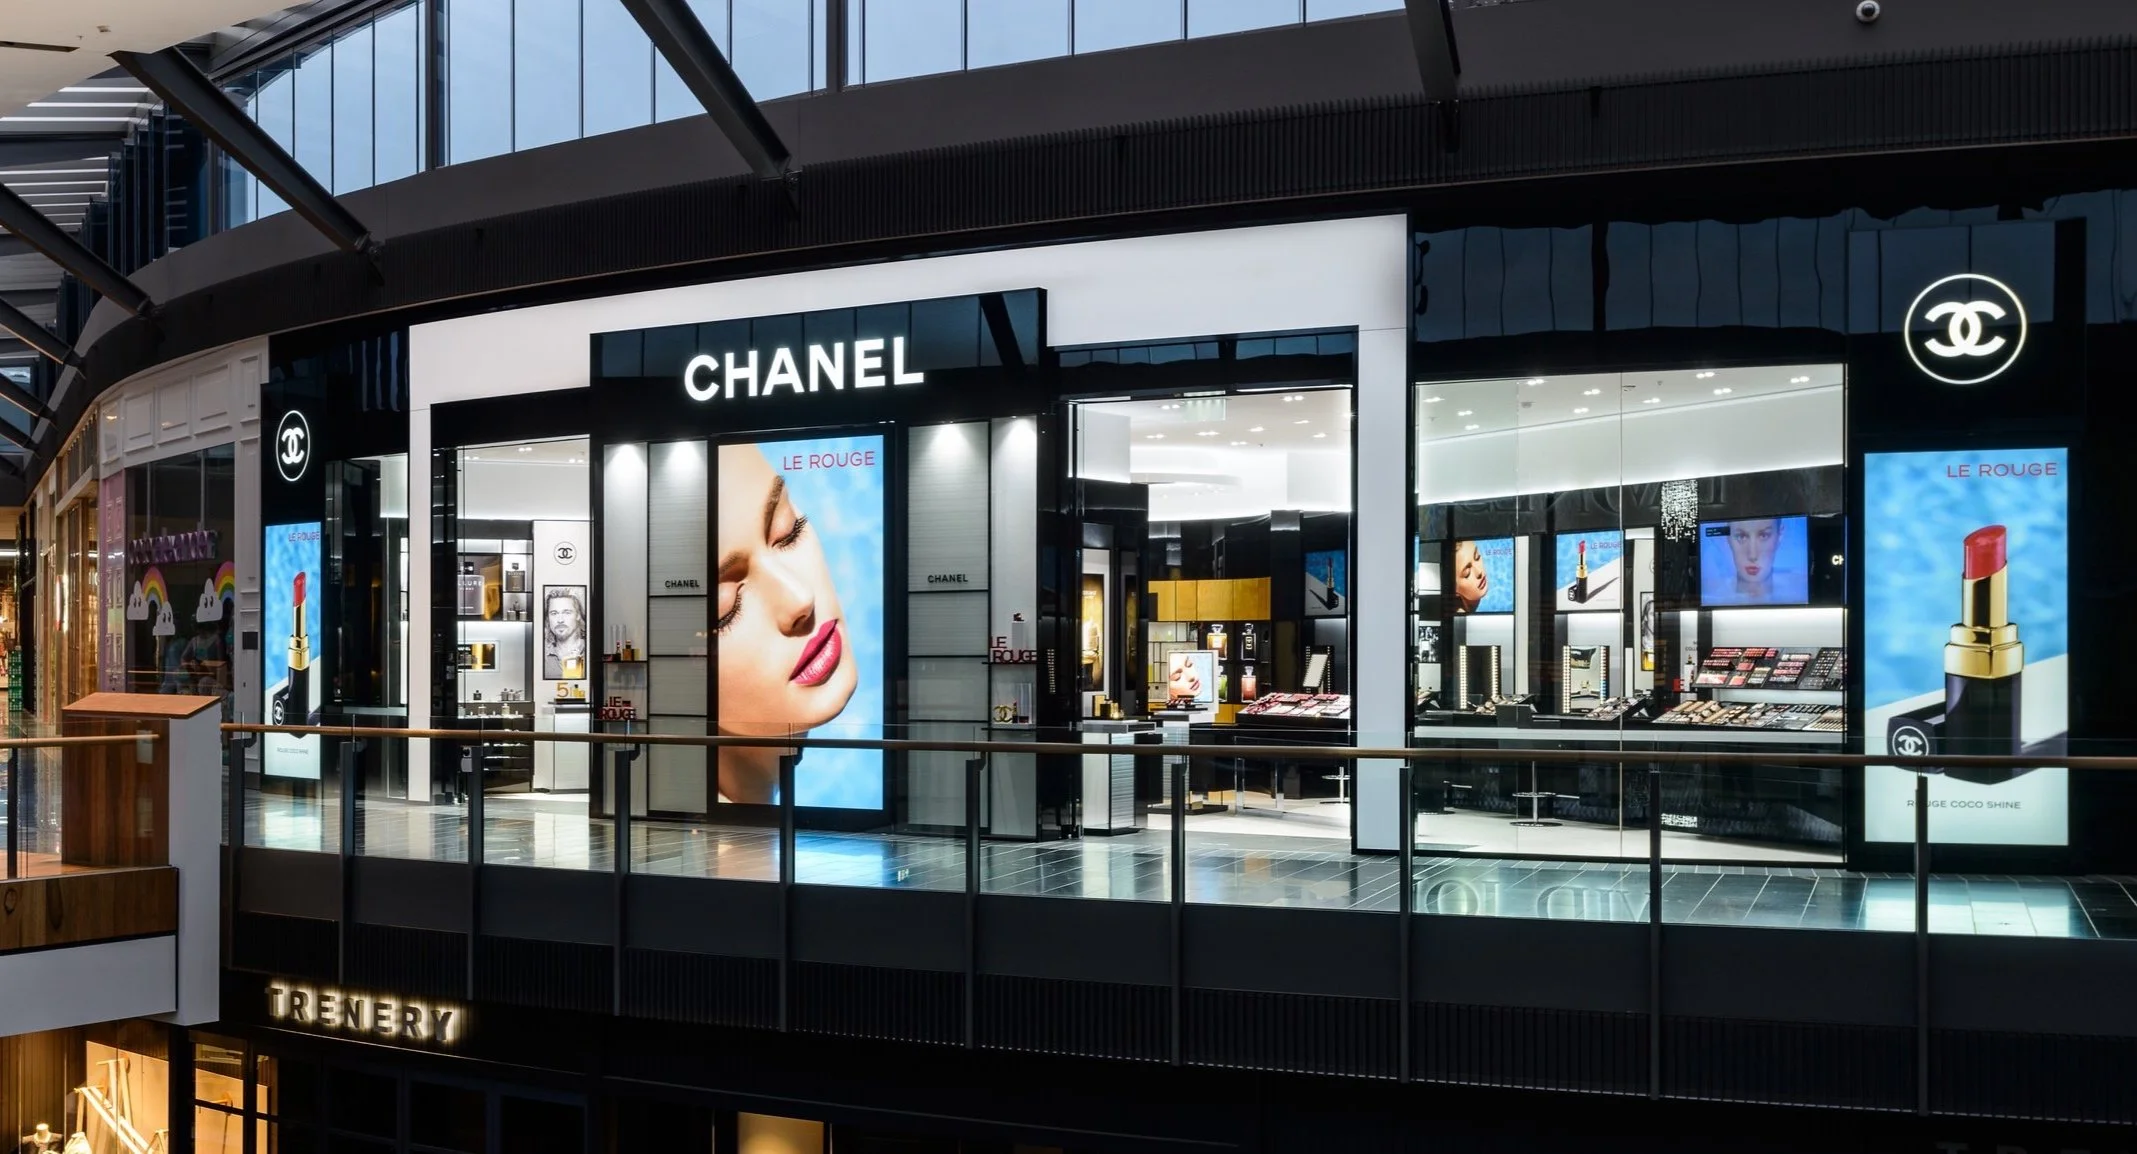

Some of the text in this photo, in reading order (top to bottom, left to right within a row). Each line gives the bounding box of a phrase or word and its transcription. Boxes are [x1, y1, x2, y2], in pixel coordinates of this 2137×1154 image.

[685, 336, 925, 402] CHANEL
[783, 450, 875, 471] LE ROUGE
[1947, 462, 2057, 478] LE ROUGE
[288, 533, 296, 542] LE
[664, 579, 700, 588] CHANEL
[927, 573, 968, 584] CHANEL
[990, 636, 1007, 649] LE
[992, 649, 1037, 663] ROUGE
[556, 682, 569, 697] 5
[609, 696, 622, 708] LE
[600, 708, 637, 720] ROUGE
[1907, 800, 2022, 810] RUGE COCO SHINE
[264, 986, 453, 1041] TRENERY
